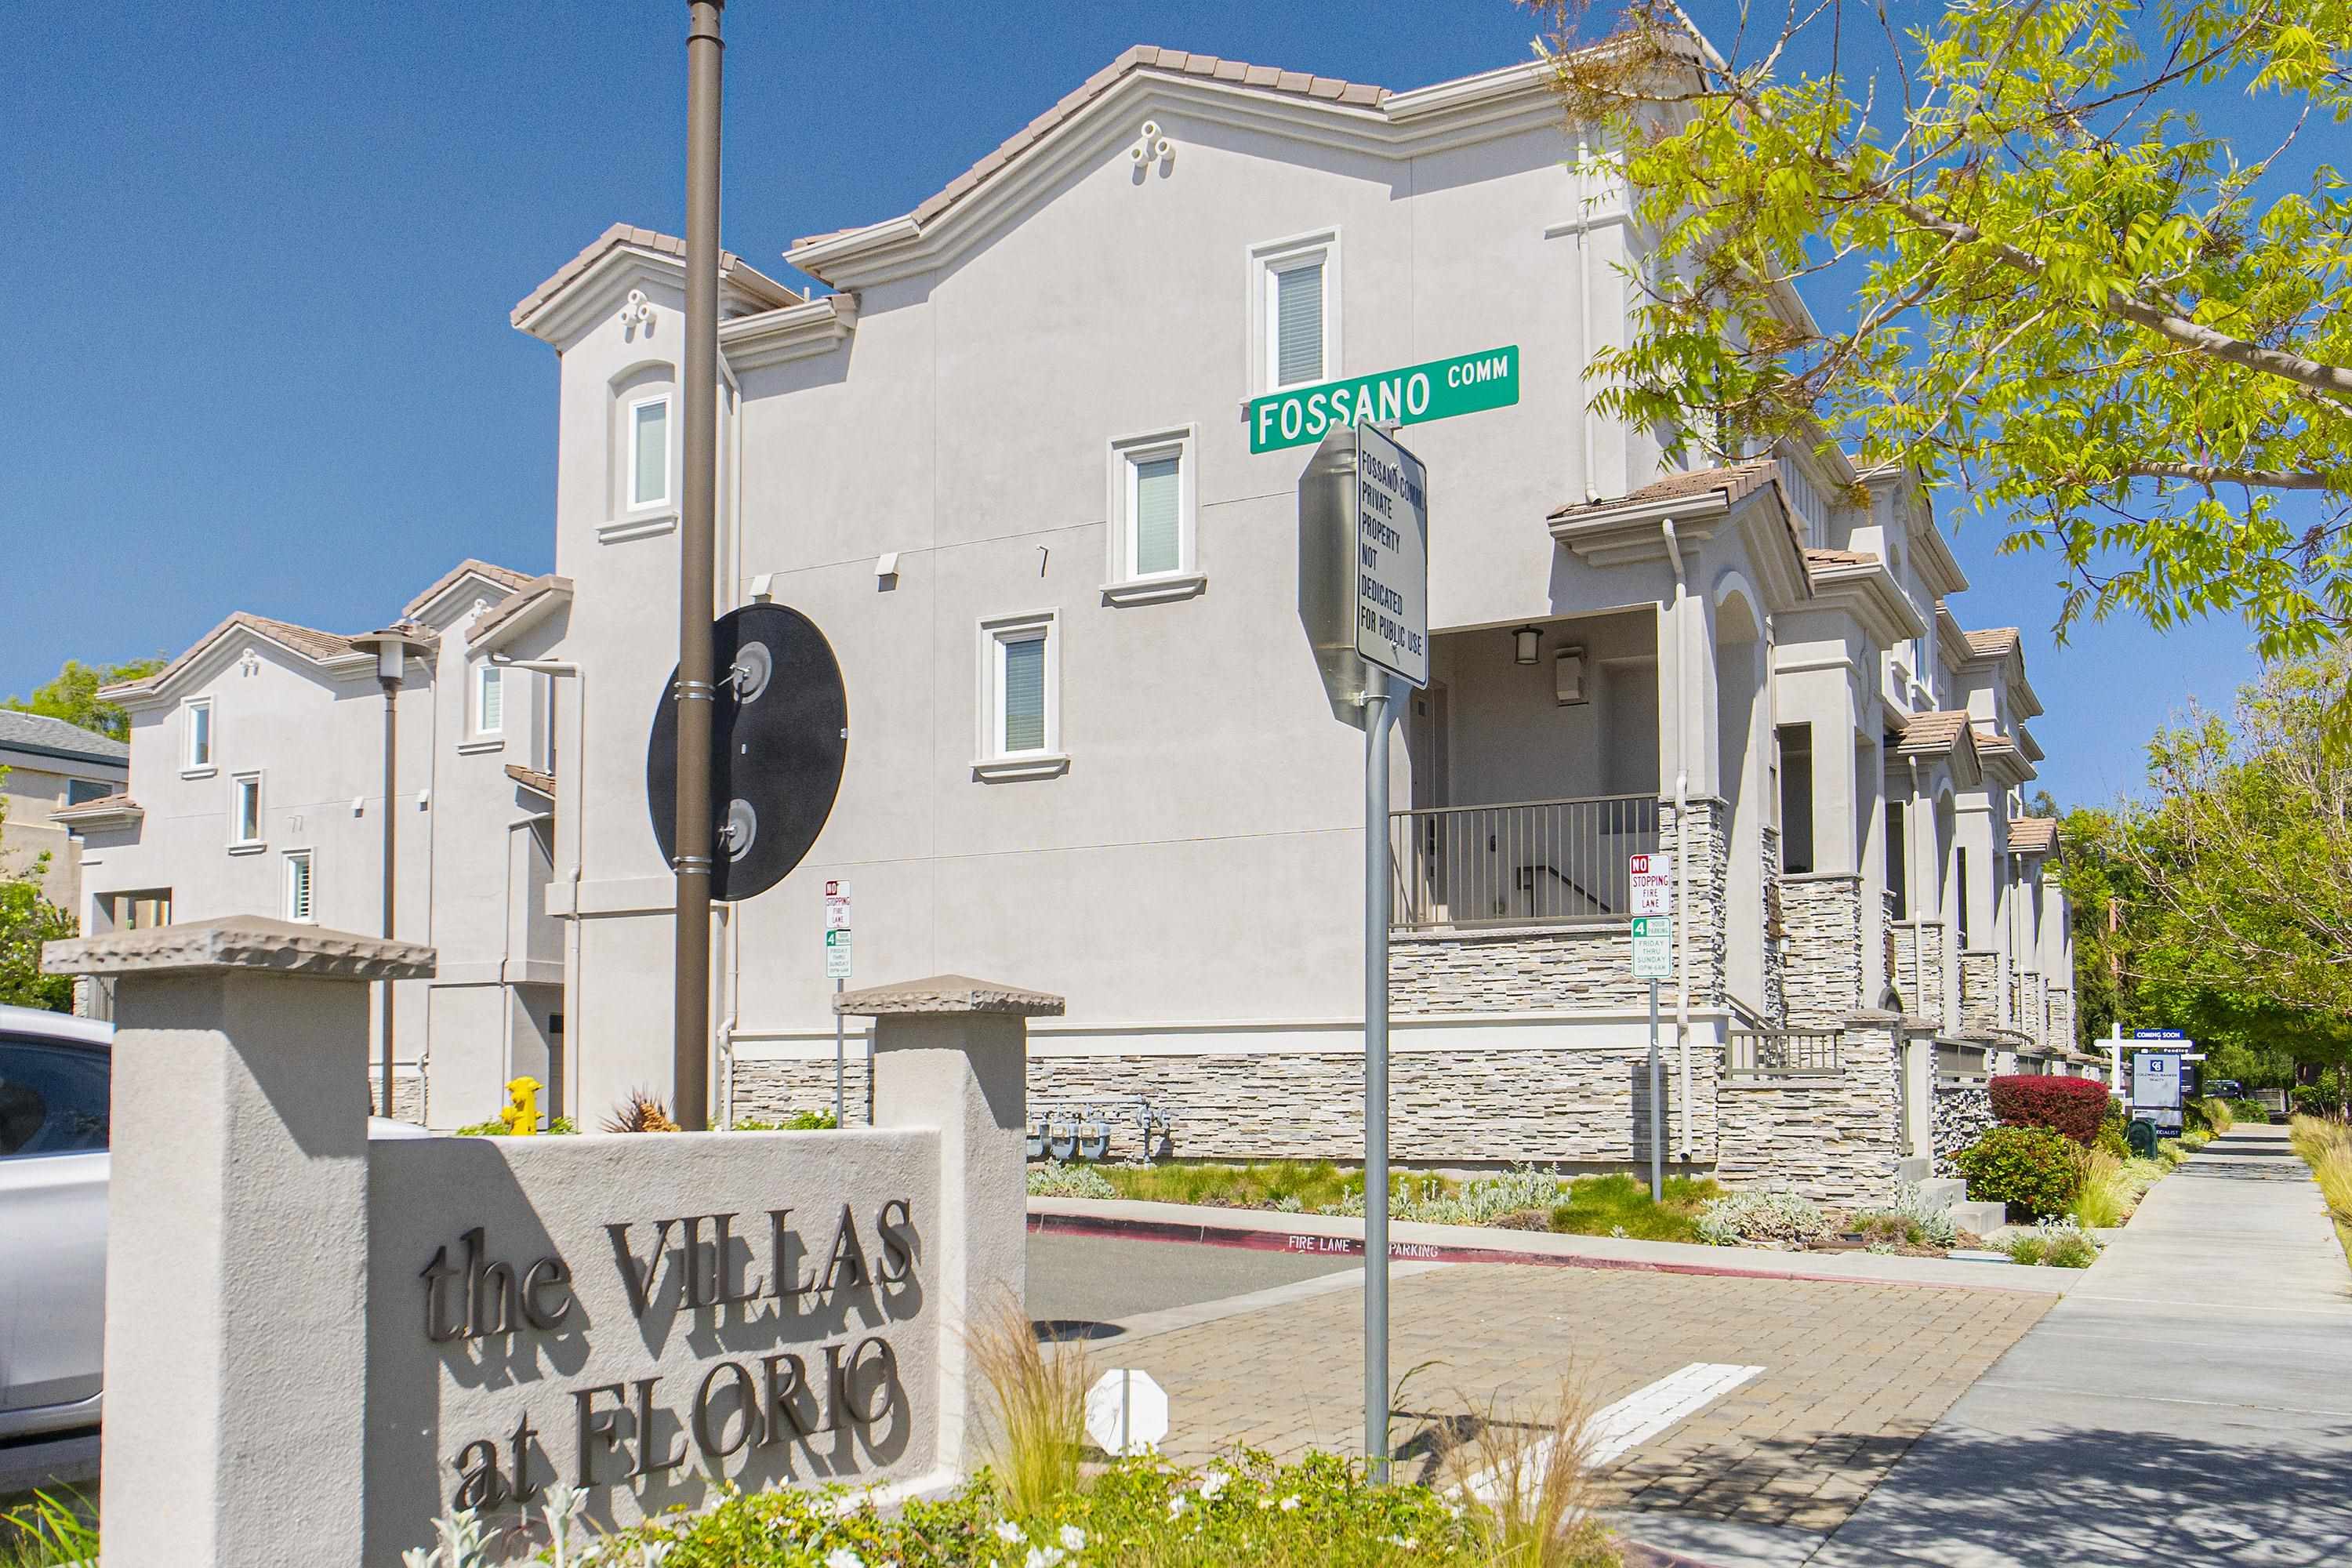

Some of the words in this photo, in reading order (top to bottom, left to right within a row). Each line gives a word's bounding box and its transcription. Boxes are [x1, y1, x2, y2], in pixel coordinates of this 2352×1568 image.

[1259, 372, 1430, 445] FOSSANO
[1448, 355, 1508, 388] COMM
[1362, 450, 1398, 492] FOSSANO
[1362, 481, 1392, 520] PRIVATE
[1362, 512, 1400, 554] PROPERTY
[1362, 543, 1377, 571] NOT
[1361, 575, 1403, 616] DEDICATED
[1360, 606, 1376, 633] FOR
[1379, 615, 1405, 648] PUBLIC
[1408, 630, 1422, 656] USE
[1632, 858, 1646, 872] NO
[827, 883, 837, 895] NO
[1633, 875, 1668, 887] STOPPING
[1643, 889, 1658, 898] FIRE
[827, 897, 850, 906] STOPPING
[1642, 899, 1659, 909] LANE
[828, 934, 834, 945] 4
[1635, 922, 1645, 935] 4
[1289, 1236, 1315, 1250] FIRE
[1319, 1238, 1350, 1253] LANE
[1388, 1242, 1439, 1258] PARKING
[419, 1226, 572, 1343] the
[604, 1198, 913, 1319] VILLAS
[453, 1410, 539, 1512] at
[568, 1336, 898, 1490] FLORIO
